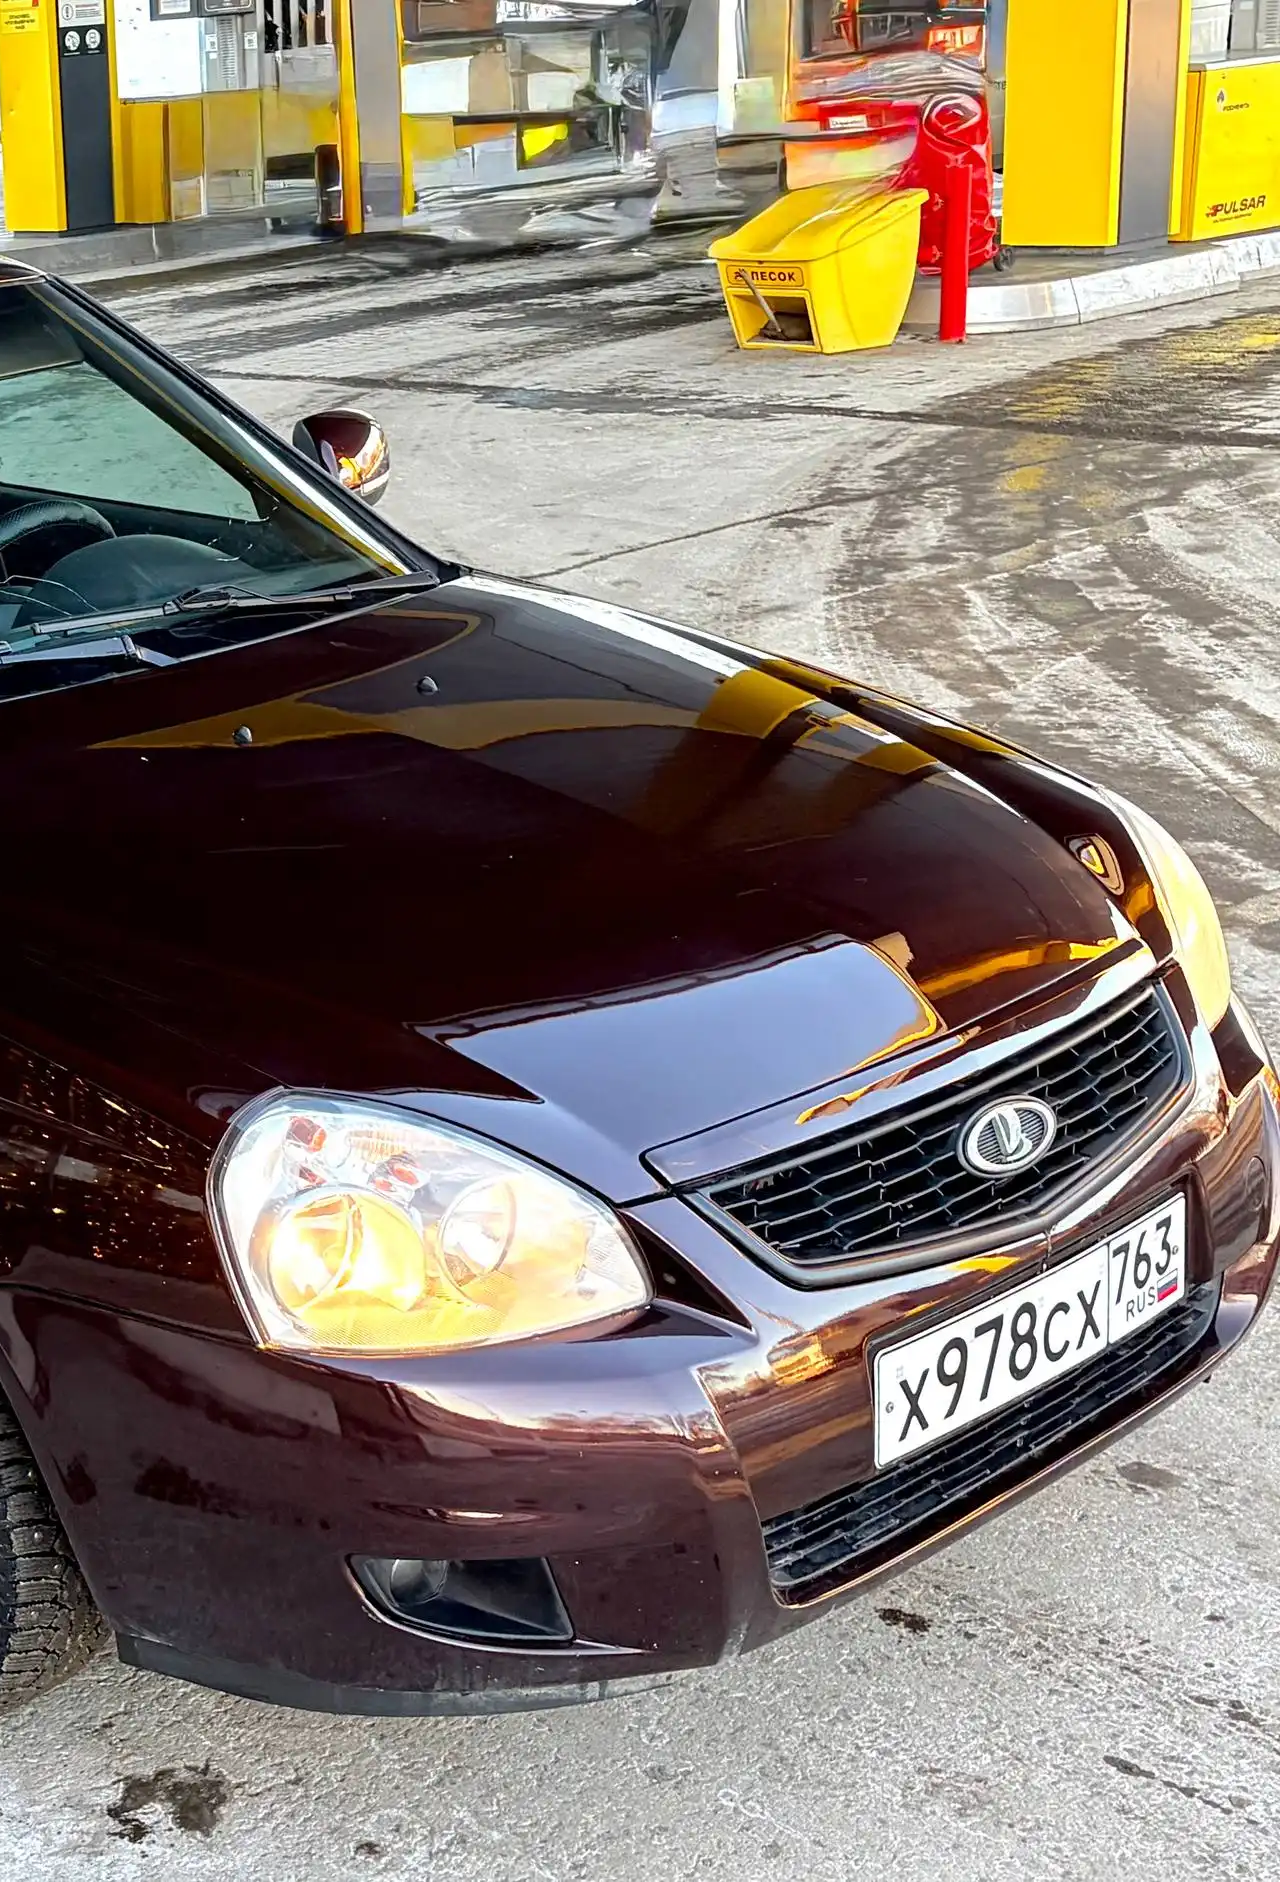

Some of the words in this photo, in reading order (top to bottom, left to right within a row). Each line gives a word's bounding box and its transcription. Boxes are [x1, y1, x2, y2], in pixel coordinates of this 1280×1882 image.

[1214, 195, 1266, 215] PULSAR
[751, 271, 796, 282] ПЕСОК
[1112, 1214, 1172, 1305] 763
[1126, 1286, 1156, 1322] RUS
